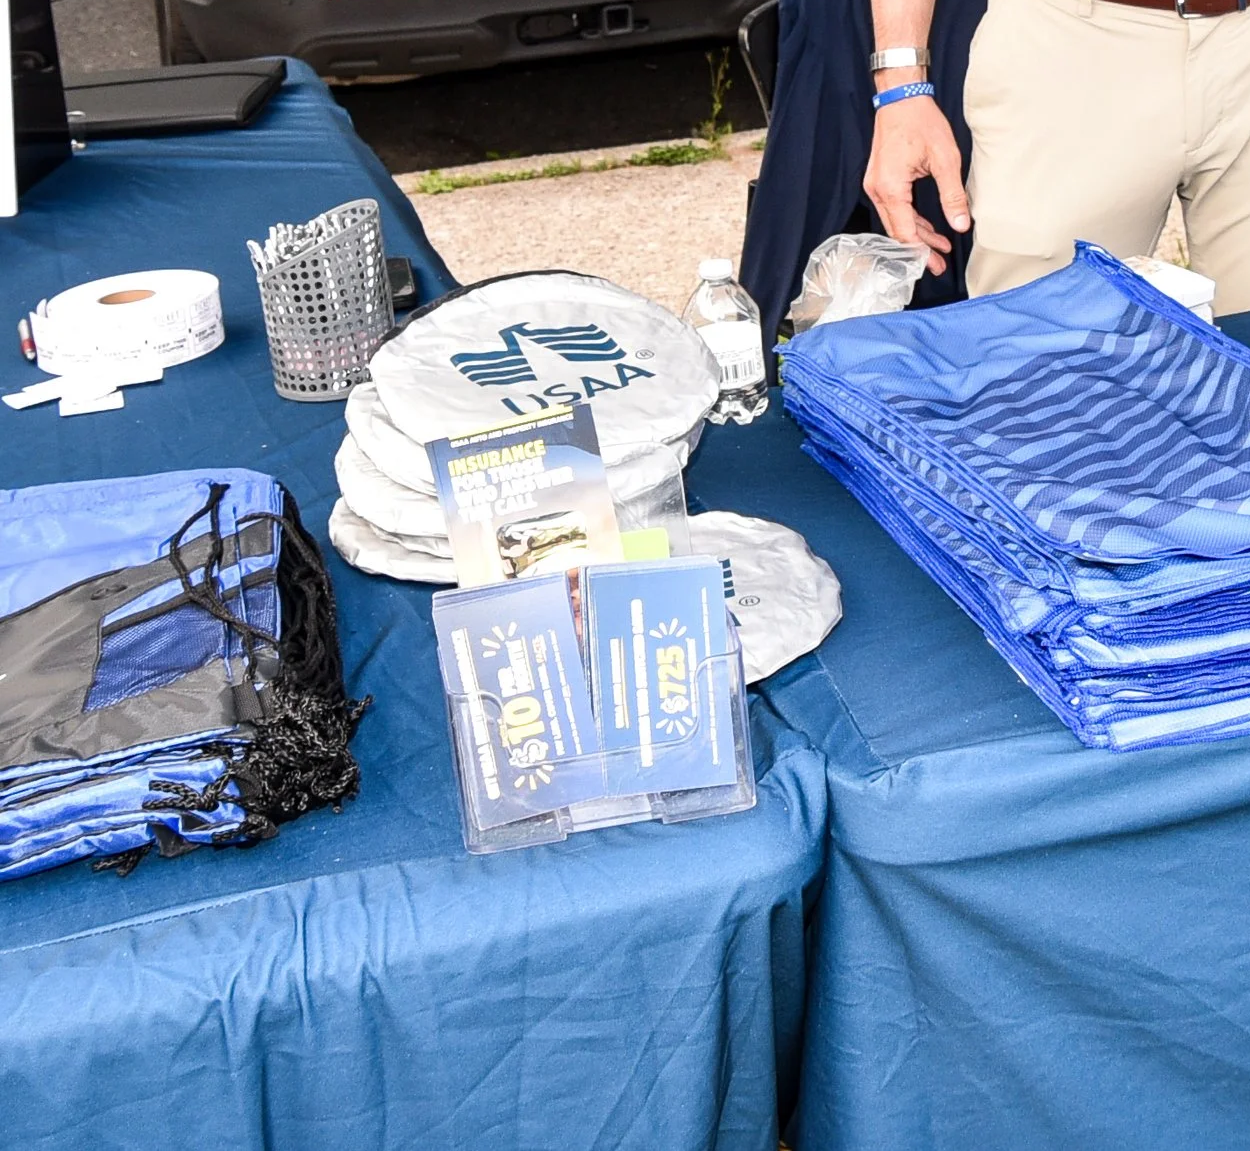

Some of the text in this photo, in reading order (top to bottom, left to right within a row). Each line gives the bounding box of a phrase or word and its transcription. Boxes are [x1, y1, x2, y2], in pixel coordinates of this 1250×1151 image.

[448, 439, 547, 477] INSURANCE
[657, 645, 689, 714] $725
[499, 696, 551, 766] $10
